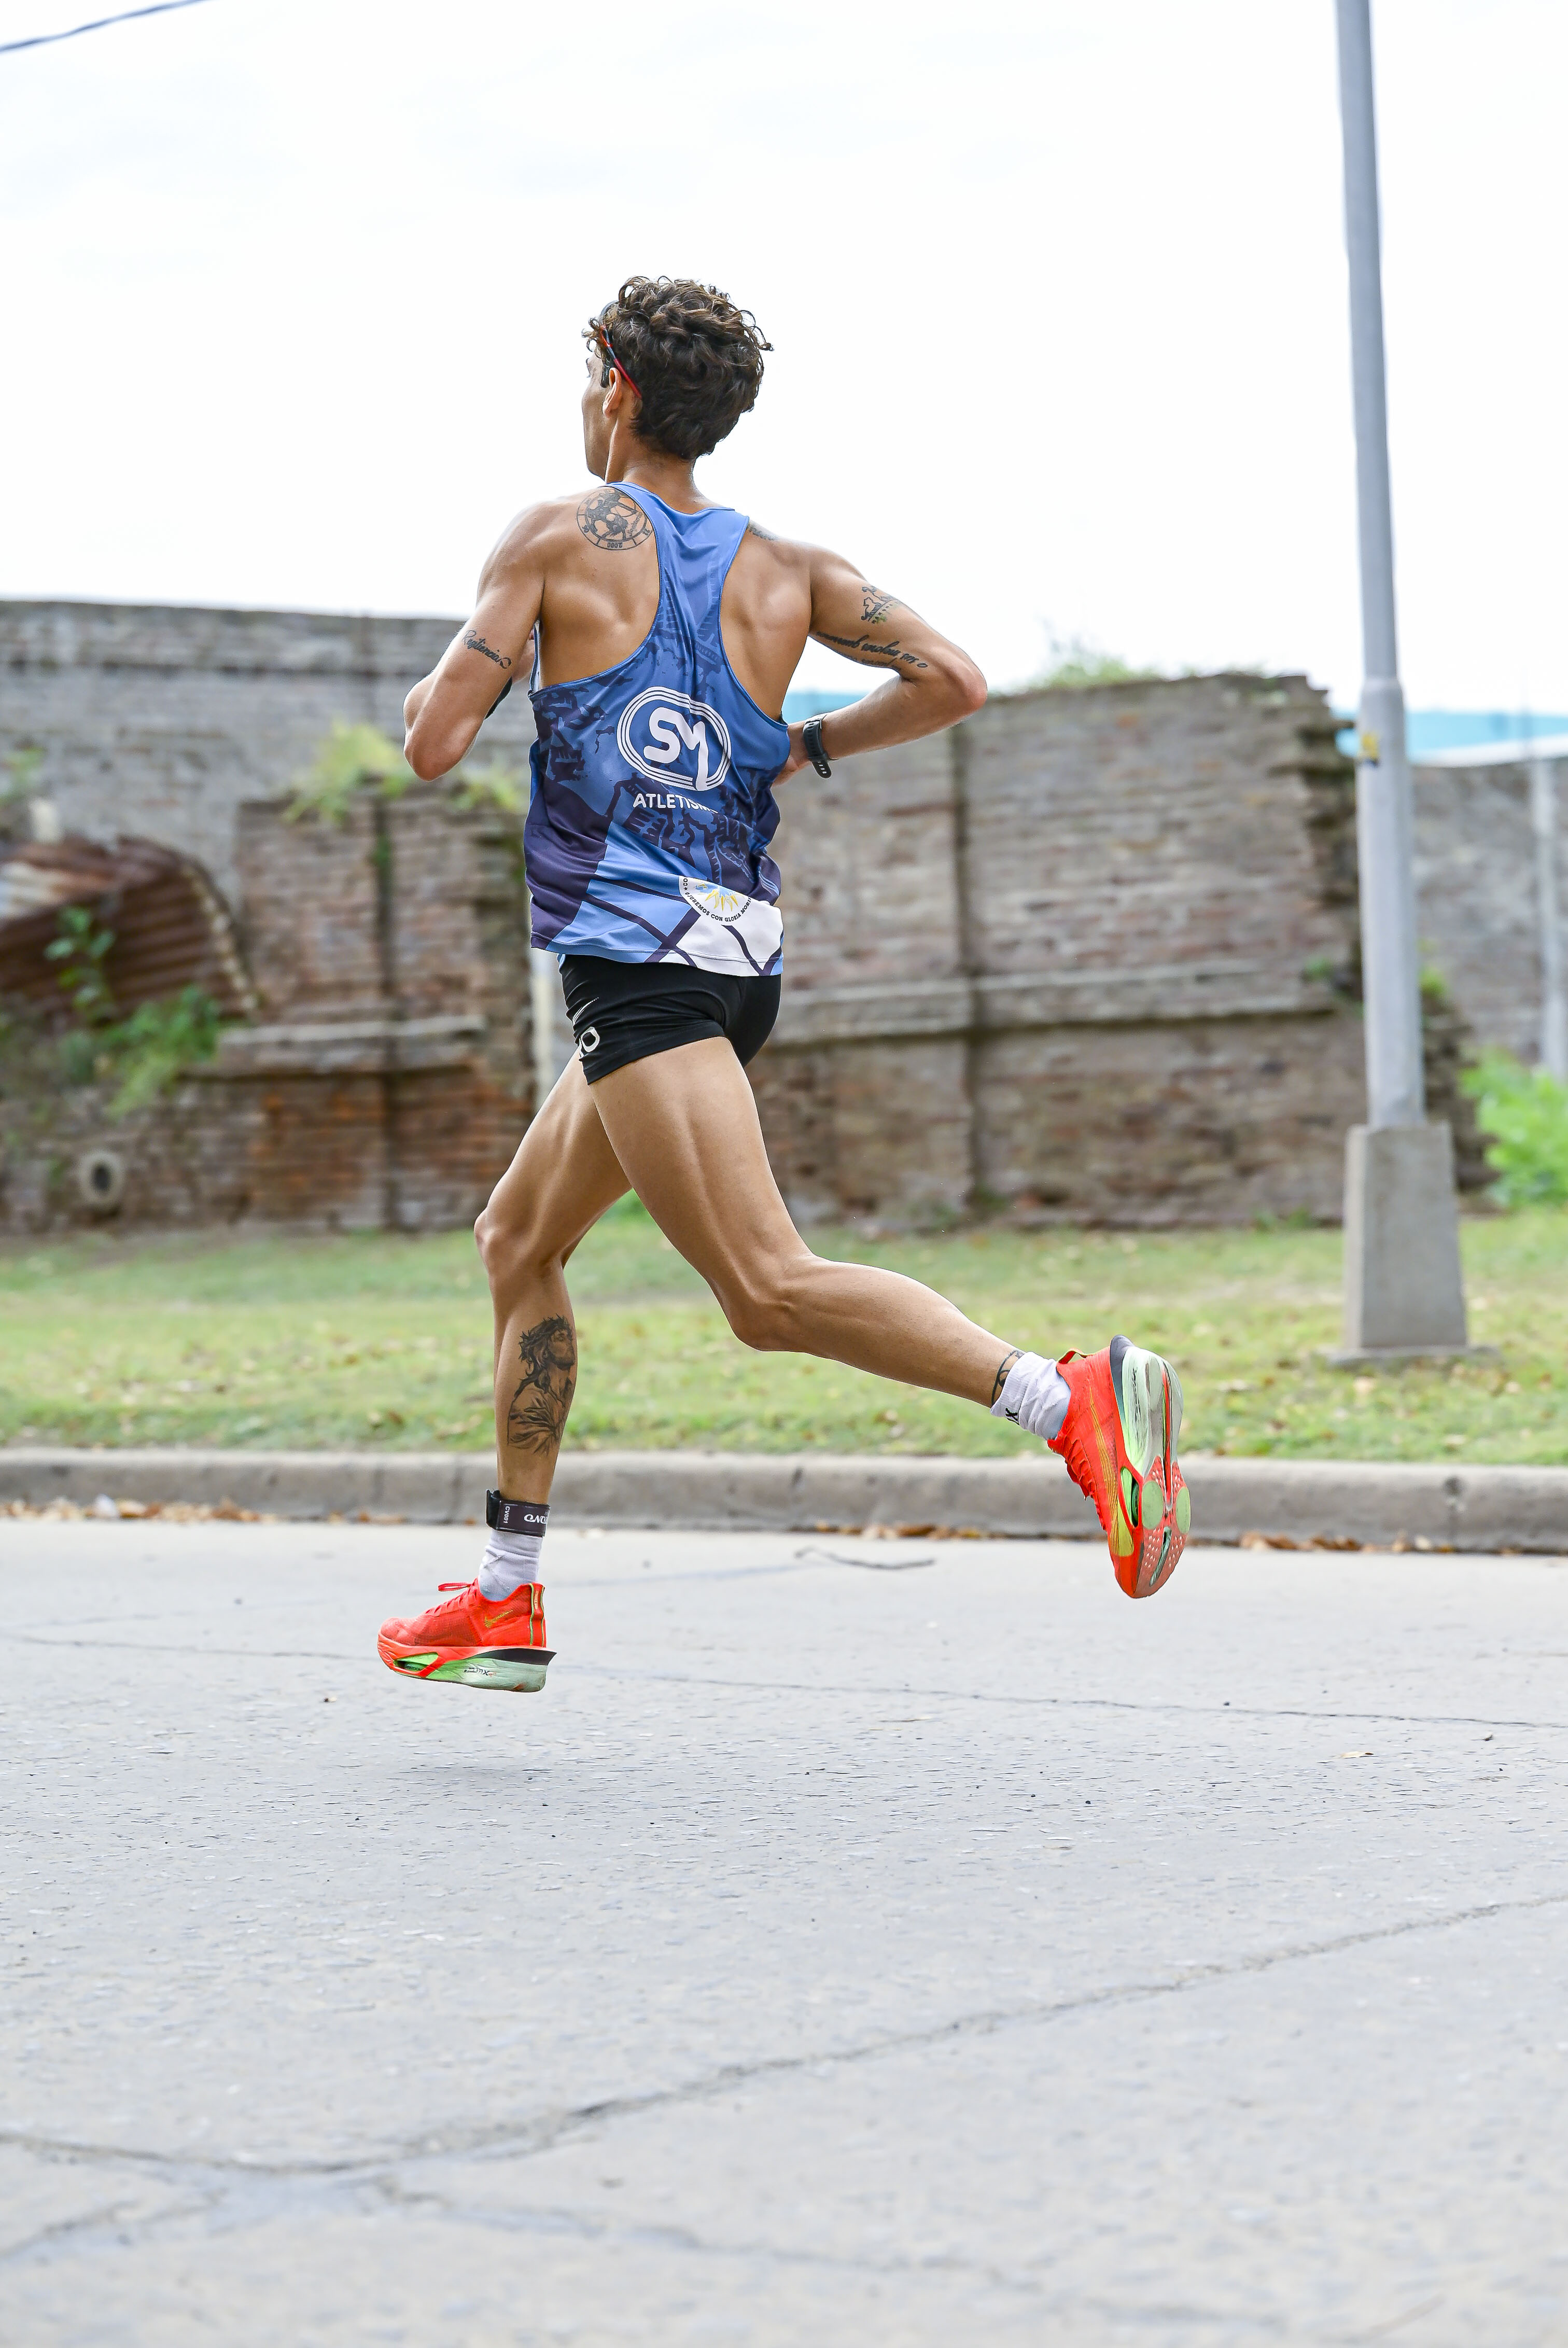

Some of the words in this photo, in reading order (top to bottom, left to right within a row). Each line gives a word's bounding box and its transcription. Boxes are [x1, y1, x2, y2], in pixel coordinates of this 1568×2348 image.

[643, 706, 709, 791] SM
[633, 793, 719, 814] ATLETISM
[724, 913, 741, 922] GLORIA
